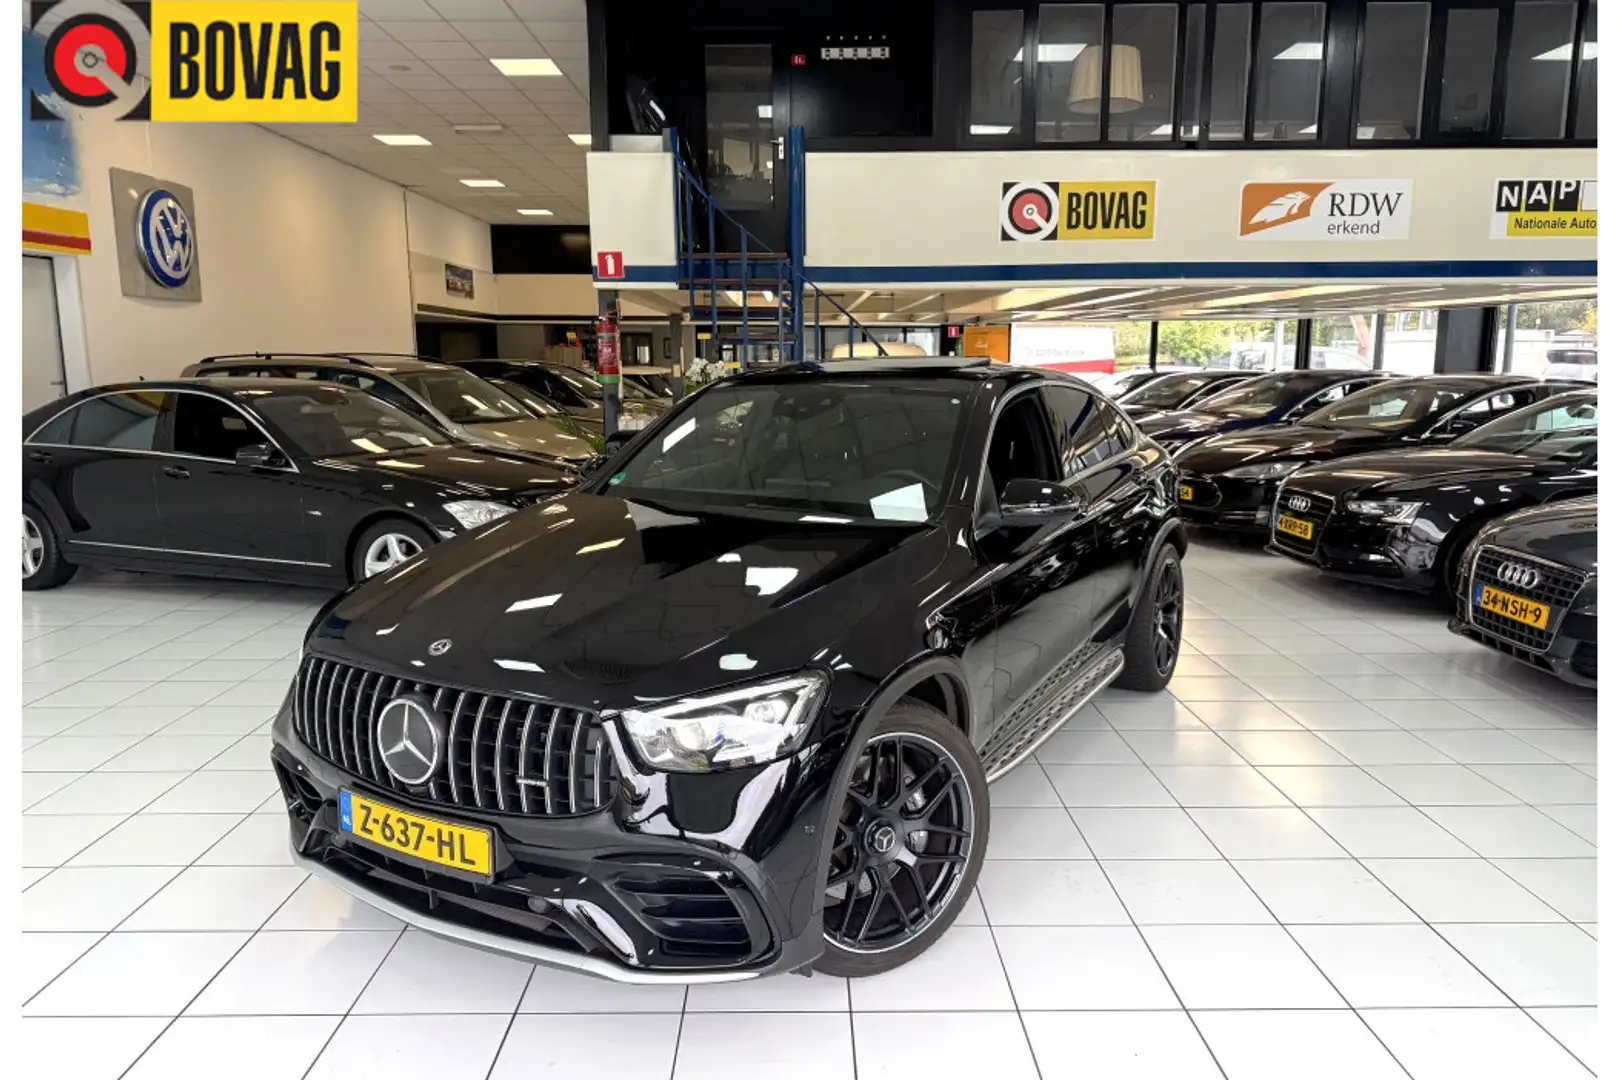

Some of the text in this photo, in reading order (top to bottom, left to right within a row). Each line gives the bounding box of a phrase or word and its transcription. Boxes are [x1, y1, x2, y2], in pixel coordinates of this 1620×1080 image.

[1327, 191, 1404, 218] RDW
[1500, 179, 1577, 208] NAP
[1066, 190, 1148, 231] BOVAG
[1513, 216, 1597, 230] Nationale Auto
[1327, 219, 1380, 235] erkend
[1482, 590, 1543, 623] 34-NSH-9
[358, 803, 477, 866] Z-637-HL
